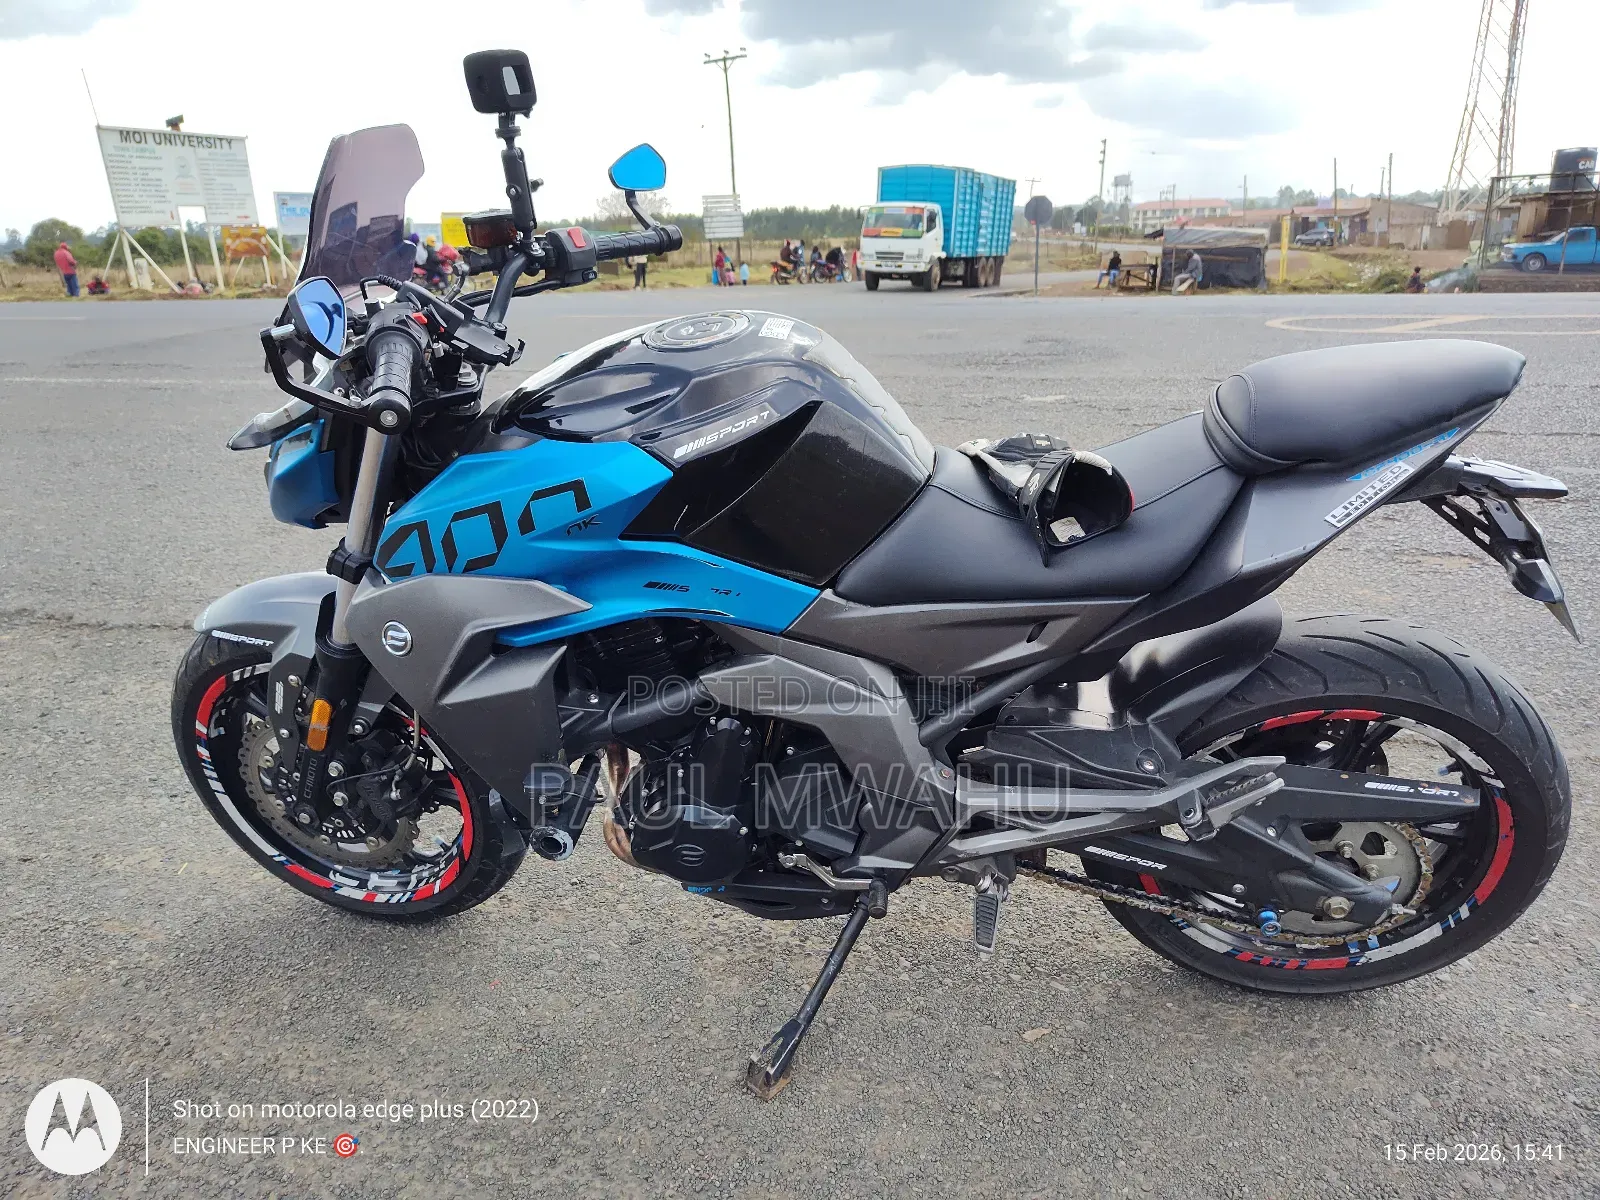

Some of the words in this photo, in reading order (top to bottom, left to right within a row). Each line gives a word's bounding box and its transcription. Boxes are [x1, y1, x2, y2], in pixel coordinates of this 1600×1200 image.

[118, 130, 148, 144] MOI
[152, 132, 233, 150] UNIVERSITY
[1330, 466, 1402, 520] LIMITED
[230, 634, 274, 646] SPORT
